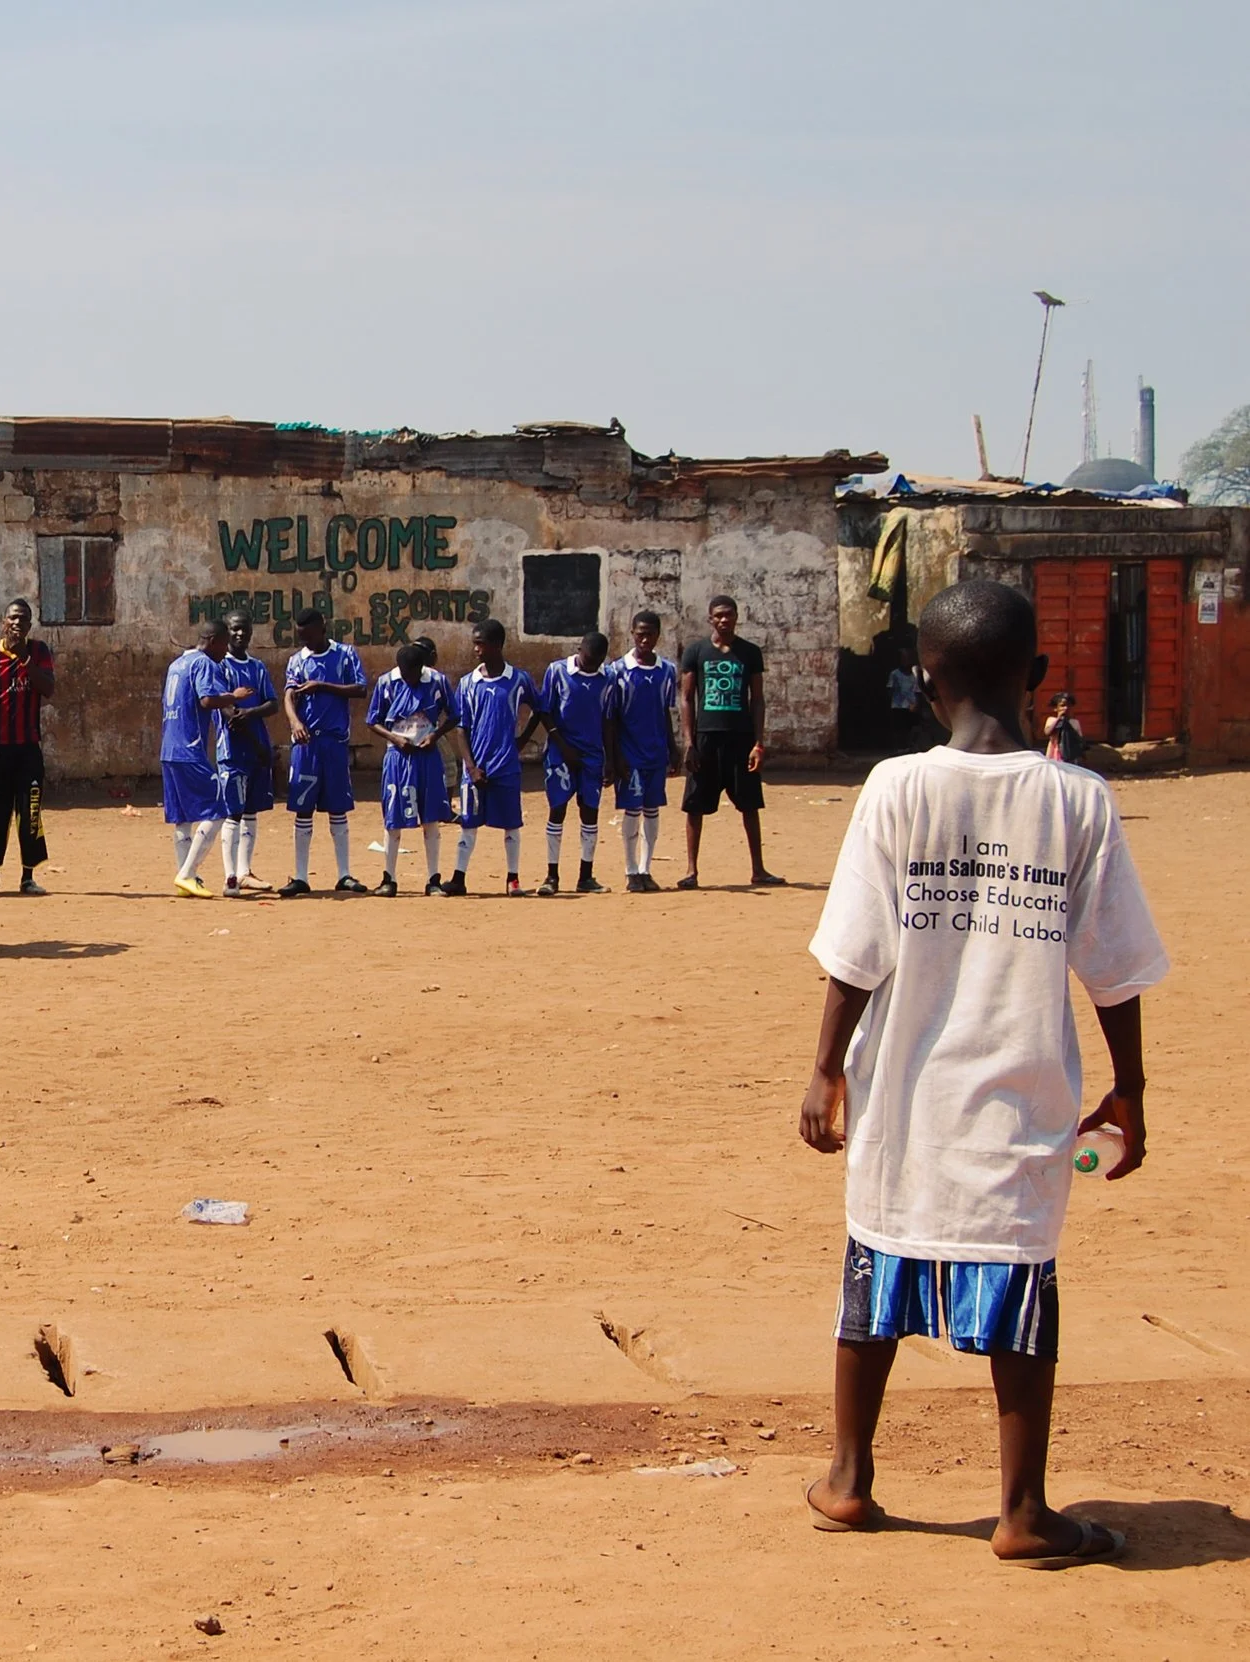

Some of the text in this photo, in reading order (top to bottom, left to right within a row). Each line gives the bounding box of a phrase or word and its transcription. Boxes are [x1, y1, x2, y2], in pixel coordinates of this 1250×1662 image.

[218, 514, 458, 574] WELCOME
[319, 571, 357, 593] TO
[369, 589, 491, 623] SPORTS
[273, 616, 411, 647] CPLEX
[297, 774, 318, 805] 7
[555, 763, 570, 791] 8
[628, 768, 643, 797] 4
[401, 785, 419, 818] 3
[962, 834, 1008, 857] I am
[949, 858, 1019, 881] Salone's
[906, 882, 980, 903] Choose
[952, 912, 1000, 935] Child
